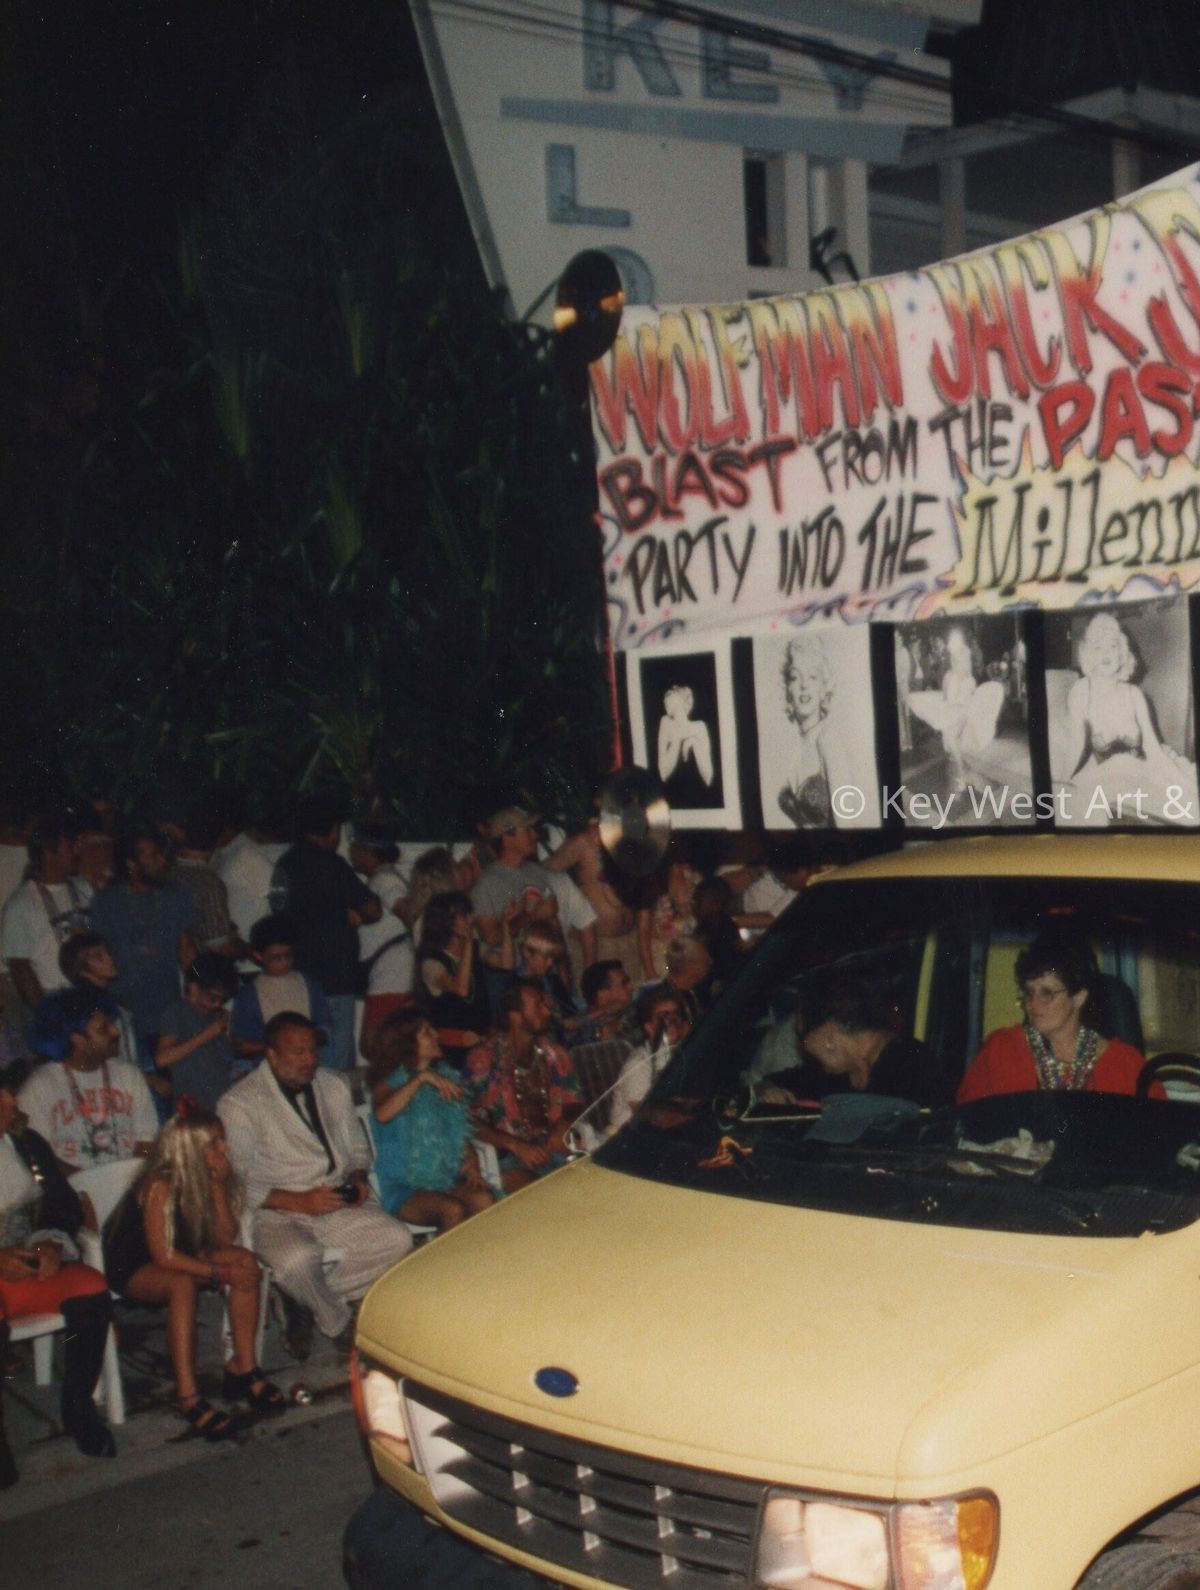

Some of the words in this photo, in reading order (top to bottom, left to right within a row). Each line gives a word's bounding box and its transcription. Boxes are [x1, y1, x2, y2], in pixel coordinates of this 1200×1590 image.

[581, 0, 900, 112] KEY
[587, 280, 904, 457] WOLFMAN
[600, 434, 796, 534] BLAST
[816, 414, 920, 494] FROM
[928, 402, 1014, 486] THE
[623, 515, 756, 616] PARTY
[779, 504, 847, 595] INTO
[858, 494, 940, 592] THE
